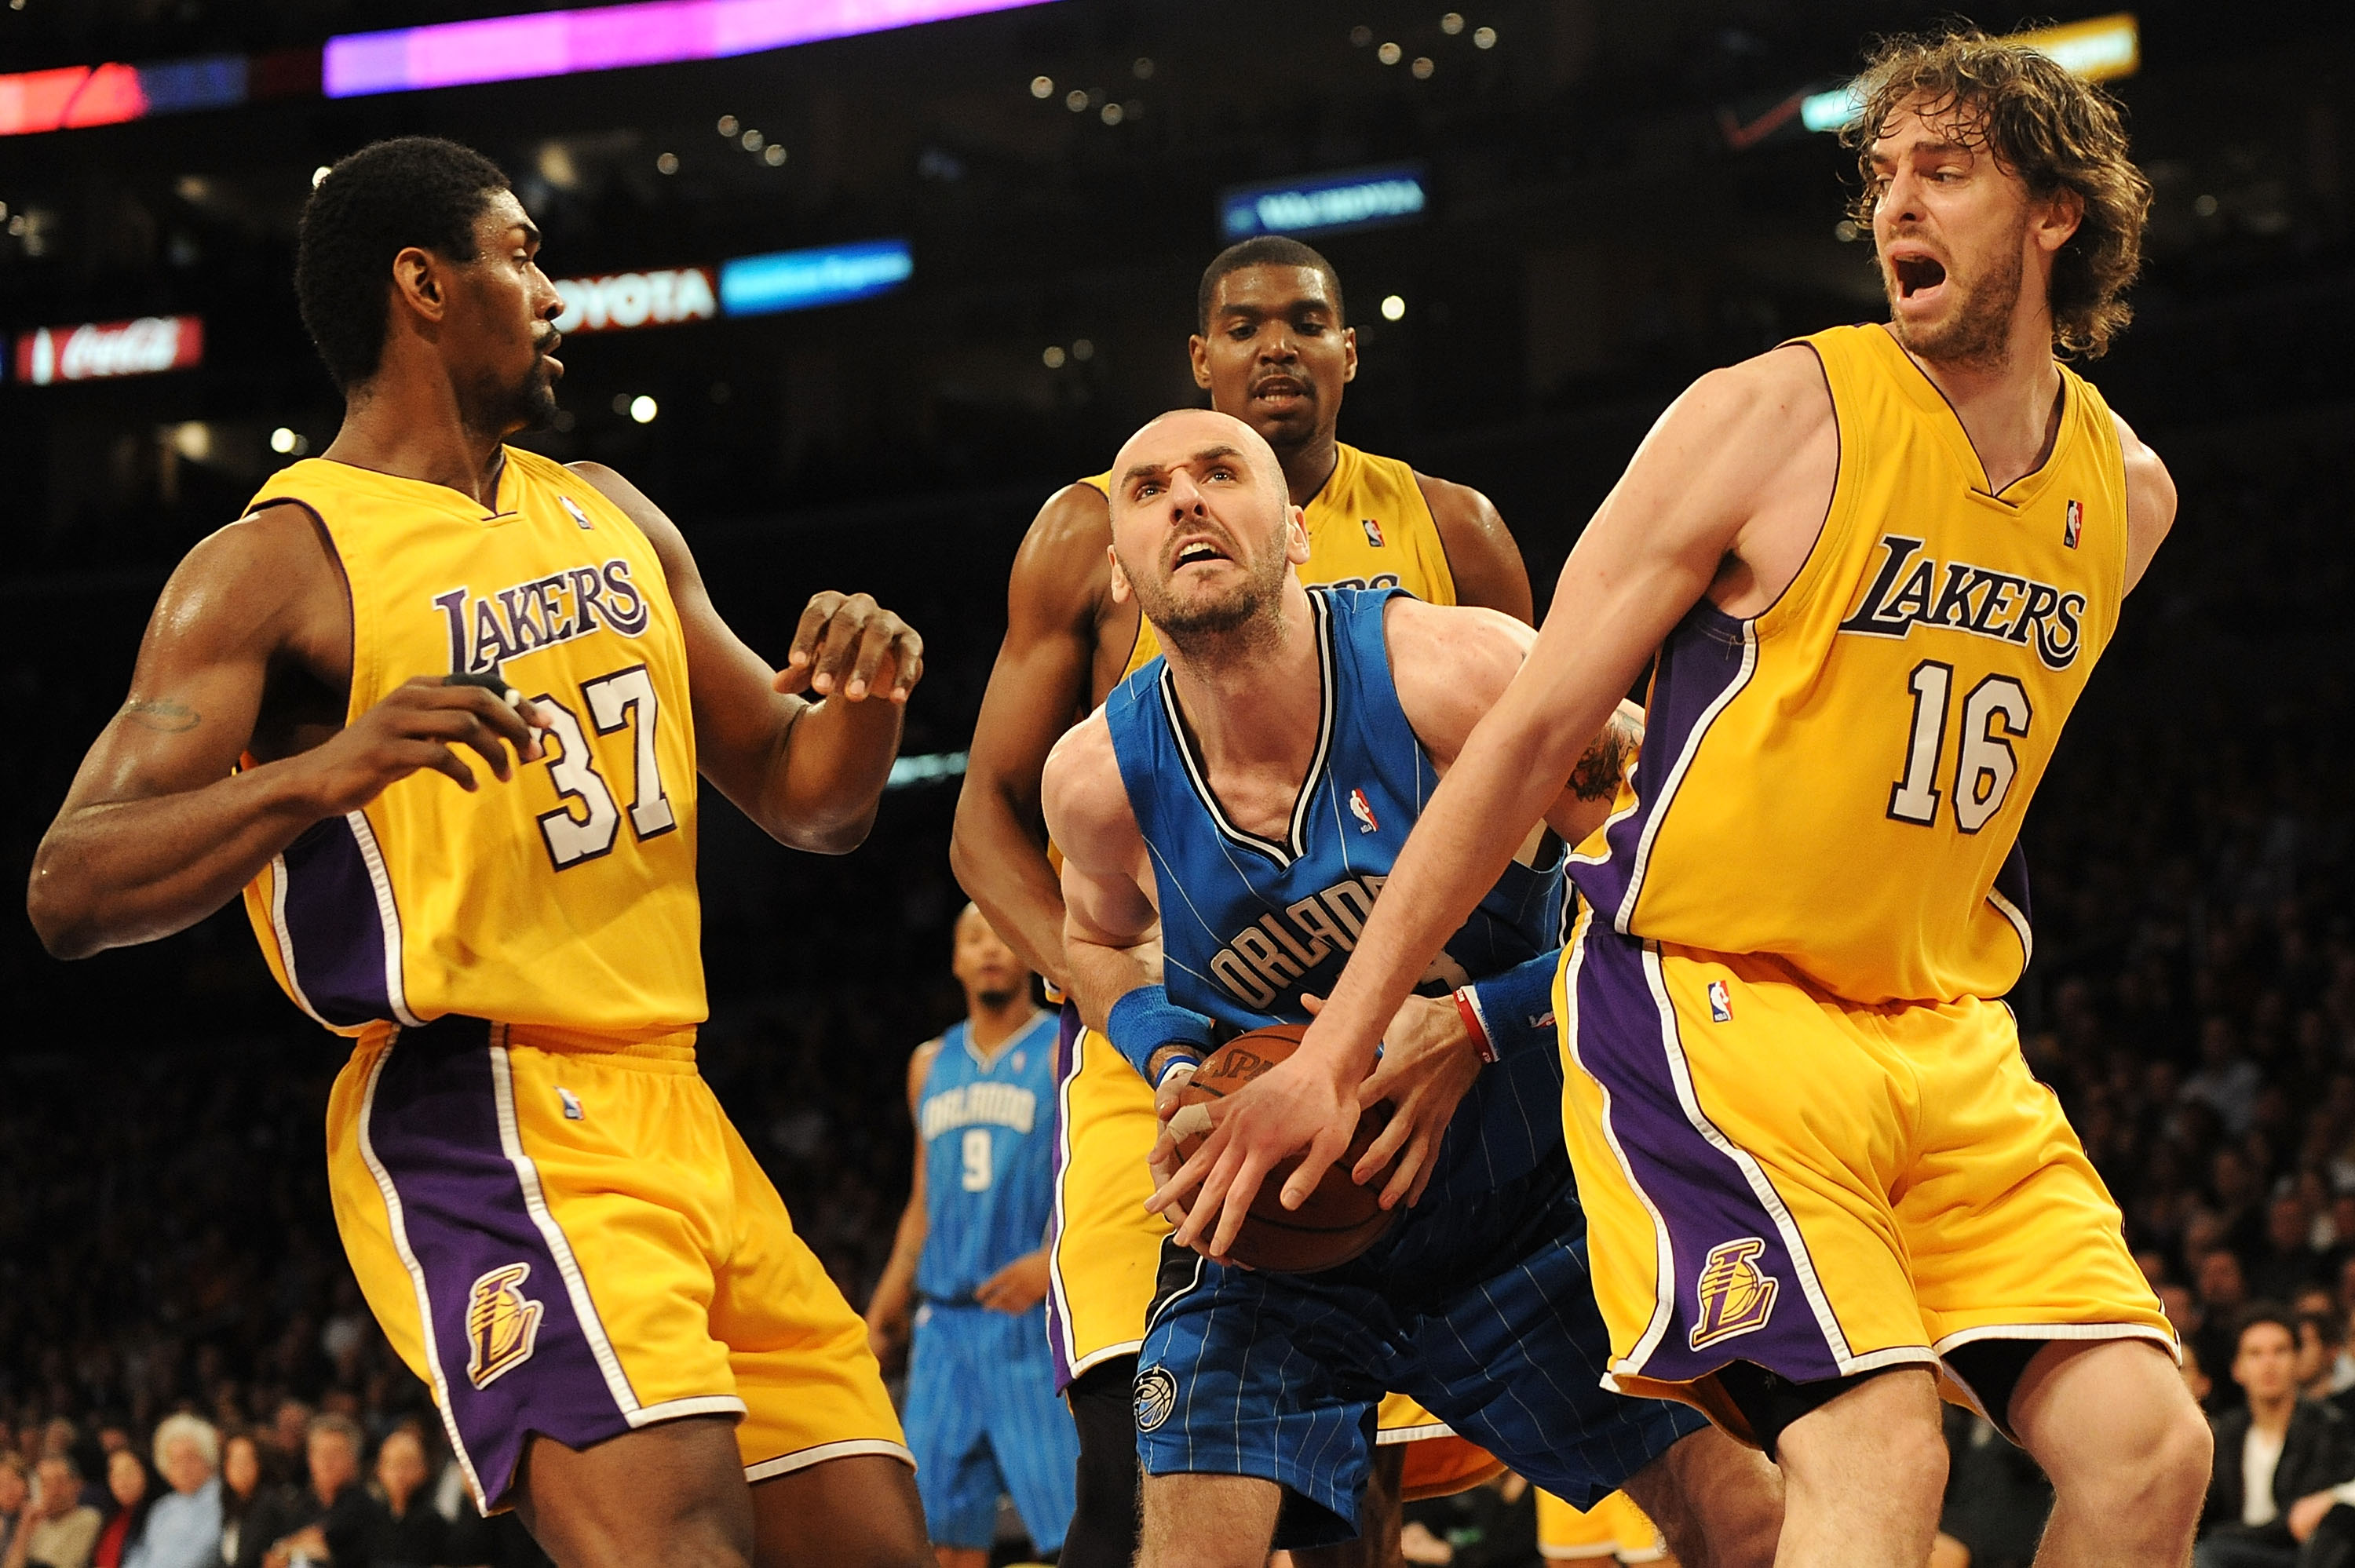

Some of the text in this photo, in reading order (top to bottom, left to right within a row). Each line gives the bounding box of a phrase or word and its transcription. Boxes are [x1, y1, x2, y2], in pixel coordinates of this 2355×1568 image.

[550, 268, 718, 334] OYOTA
[432, 558, 648, 680] LAKERS
[1838, 534, 2087, 672] LAKERS
[519, 664, 677, 873] 37
[1886, 658, 2033, 834] 16
[1210, 876, 1389, 1010] ORLAN
[962, 1129, 991, 1193] 9
